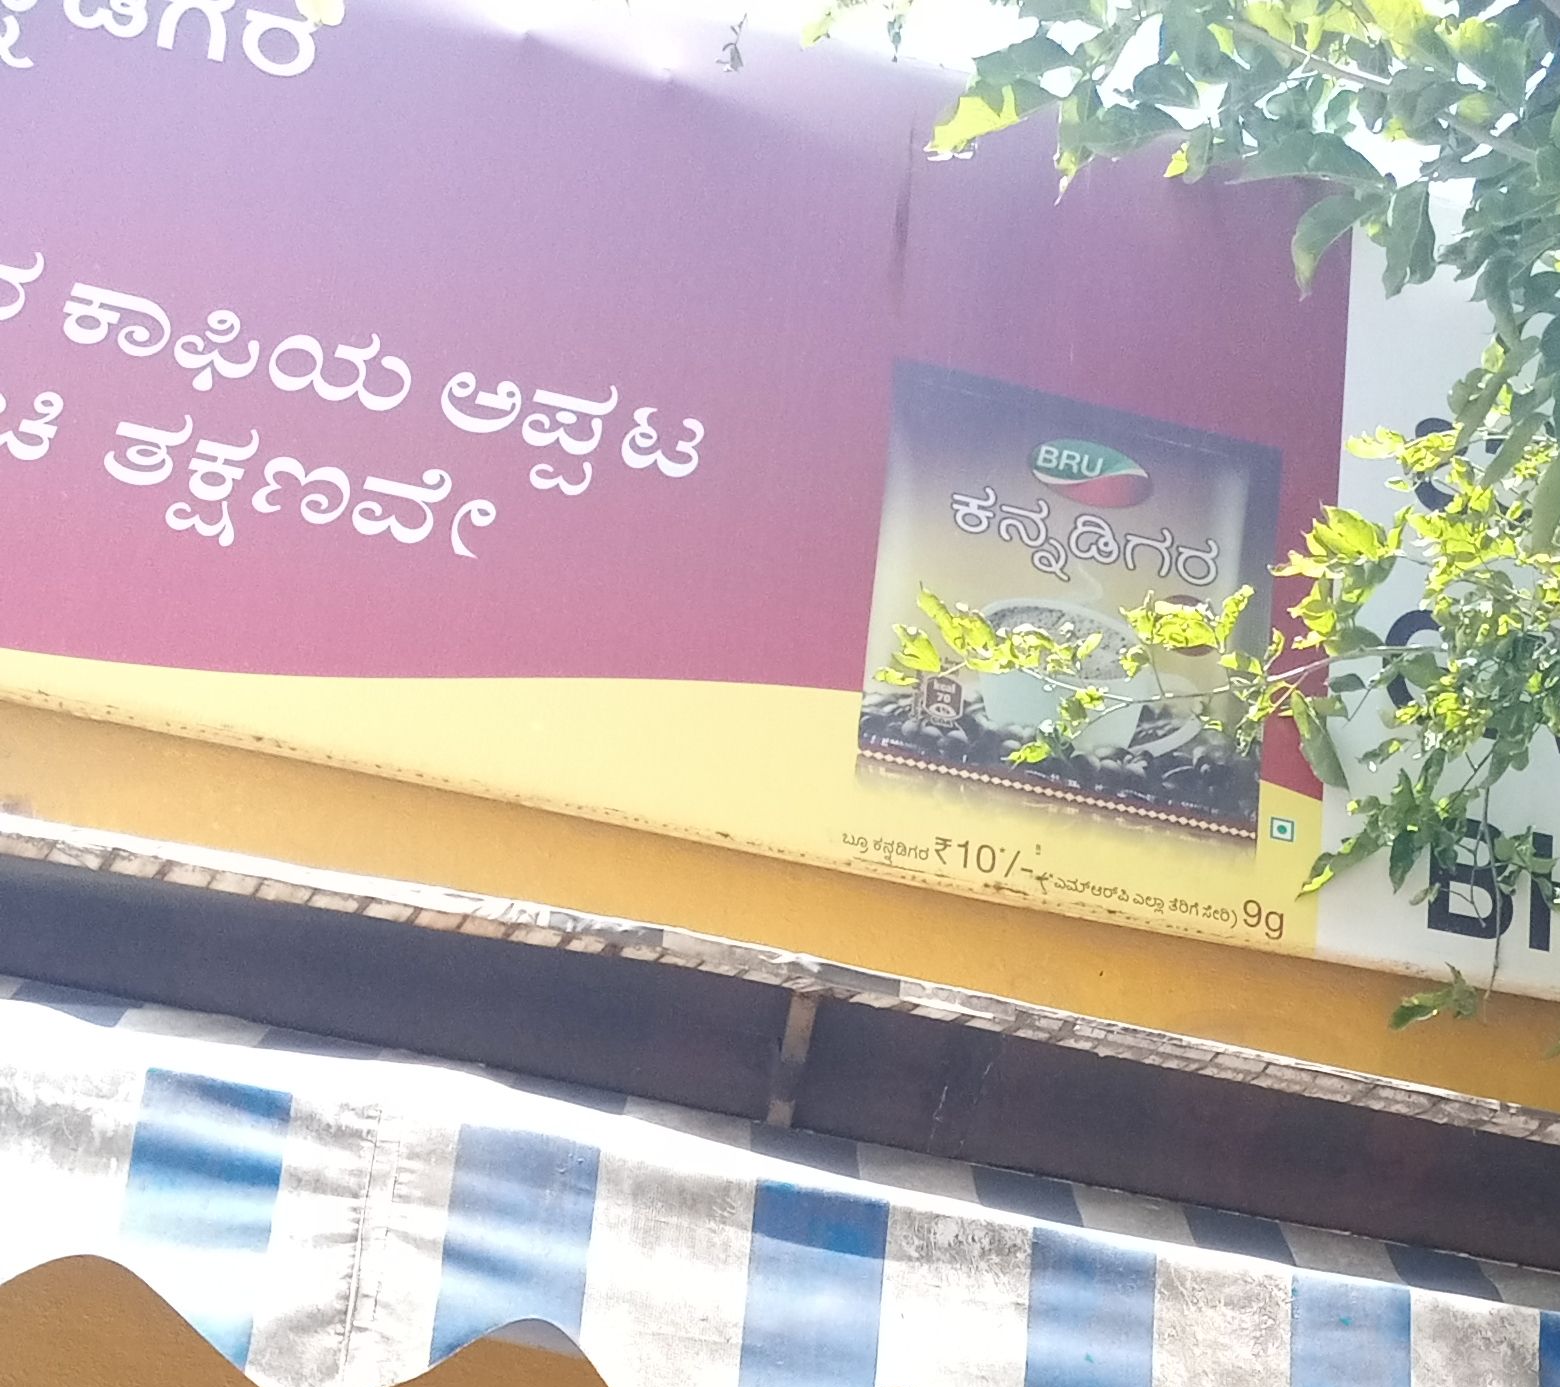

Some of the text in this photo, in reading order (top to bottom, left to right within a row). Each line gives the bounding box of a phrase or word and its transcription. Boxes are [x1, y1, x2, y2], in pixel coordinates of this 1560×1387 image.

[62, 282, 412, 413] ಕಾಫಿಯ
[440, 371, 706, 496] ಅಪ್ಪಟ
[103, 414, 497, 559] ತಕ್ಷಣವೇ
[1035, 442, 1104, 478] BRU
[950, 485, 1220, 588] ಕನ್ನಡಿಗರ
[1241, 898, 1286, 942] 9g
